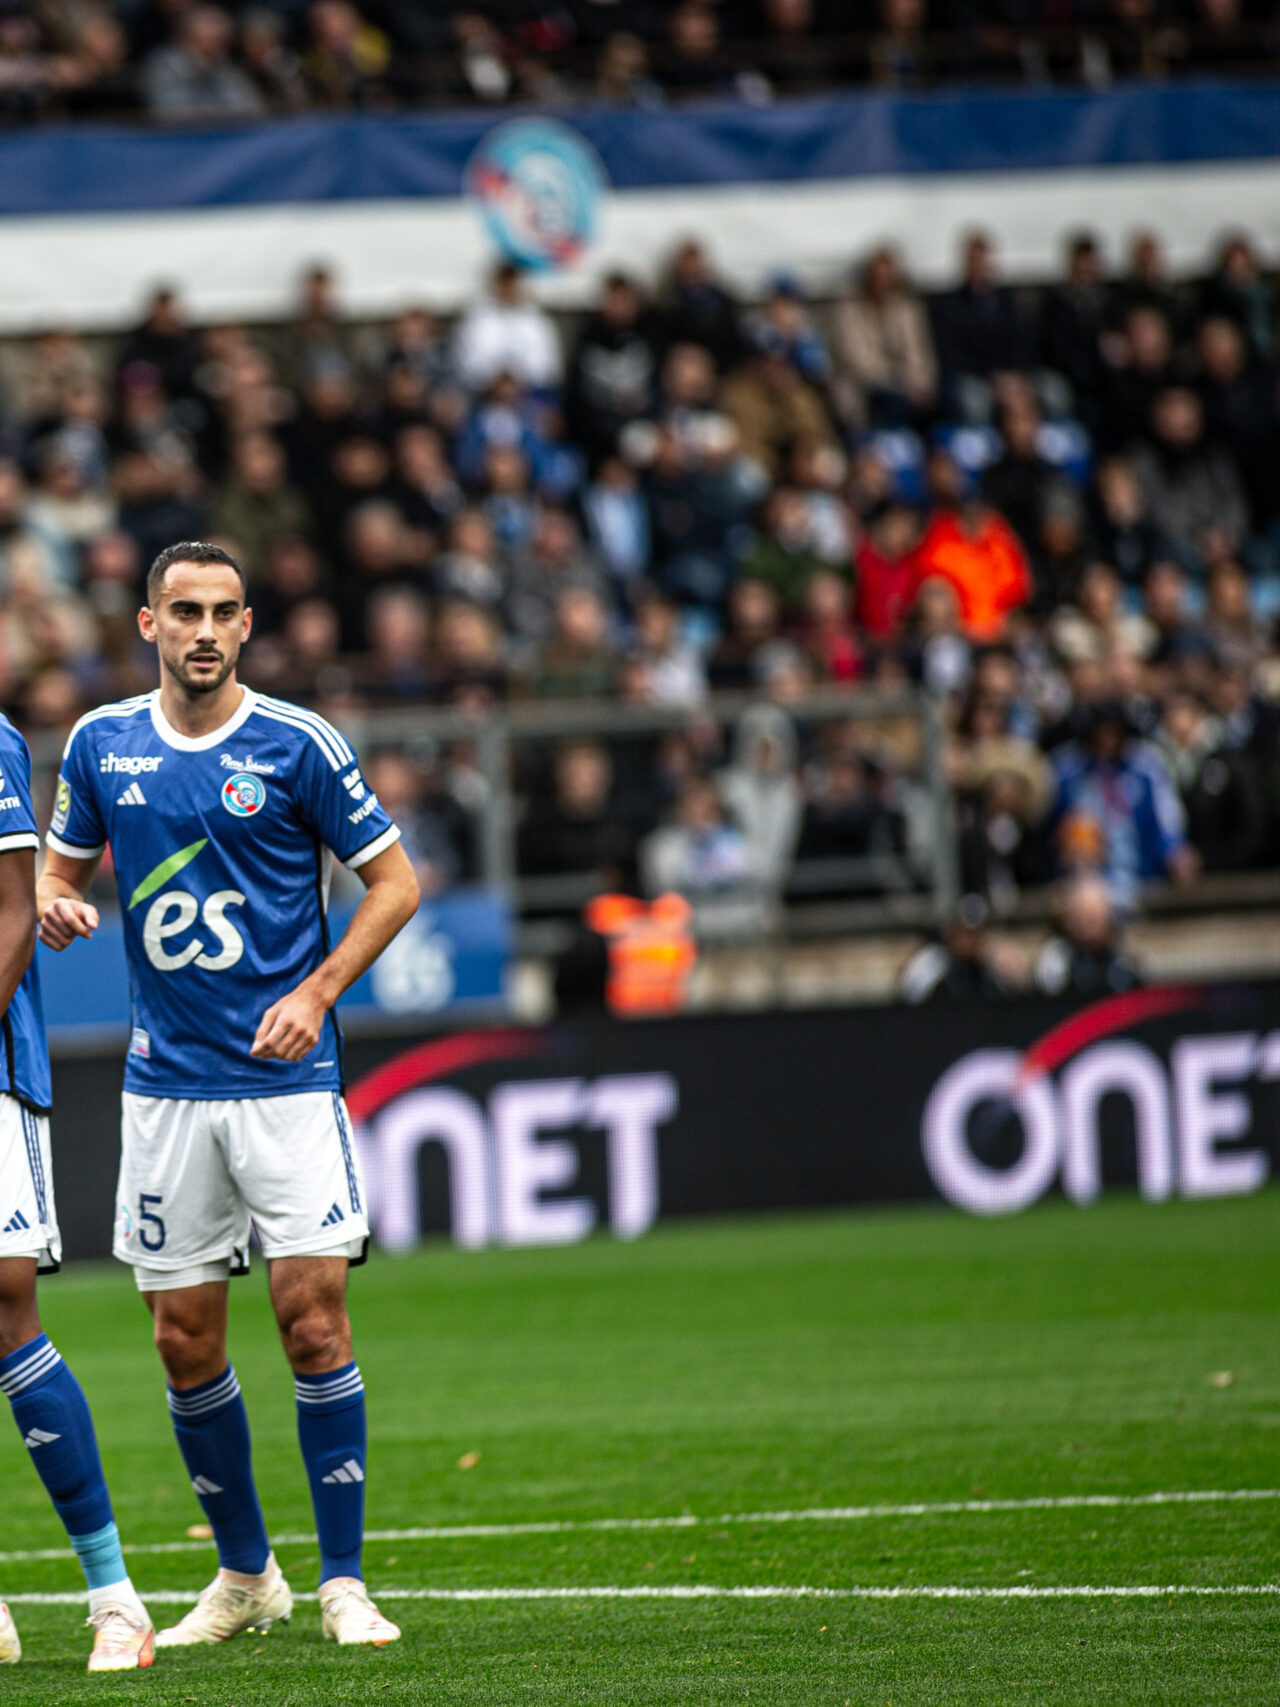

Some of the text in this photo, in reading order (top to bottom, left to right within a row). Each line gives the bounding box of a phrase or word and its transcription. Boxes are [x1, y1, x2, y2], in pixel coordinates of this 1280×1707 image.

[358, 1070, 678, 1252] NET
[923, 1028, 1280, 1218] ONE
[137, 1194, 167, 1251] 5
